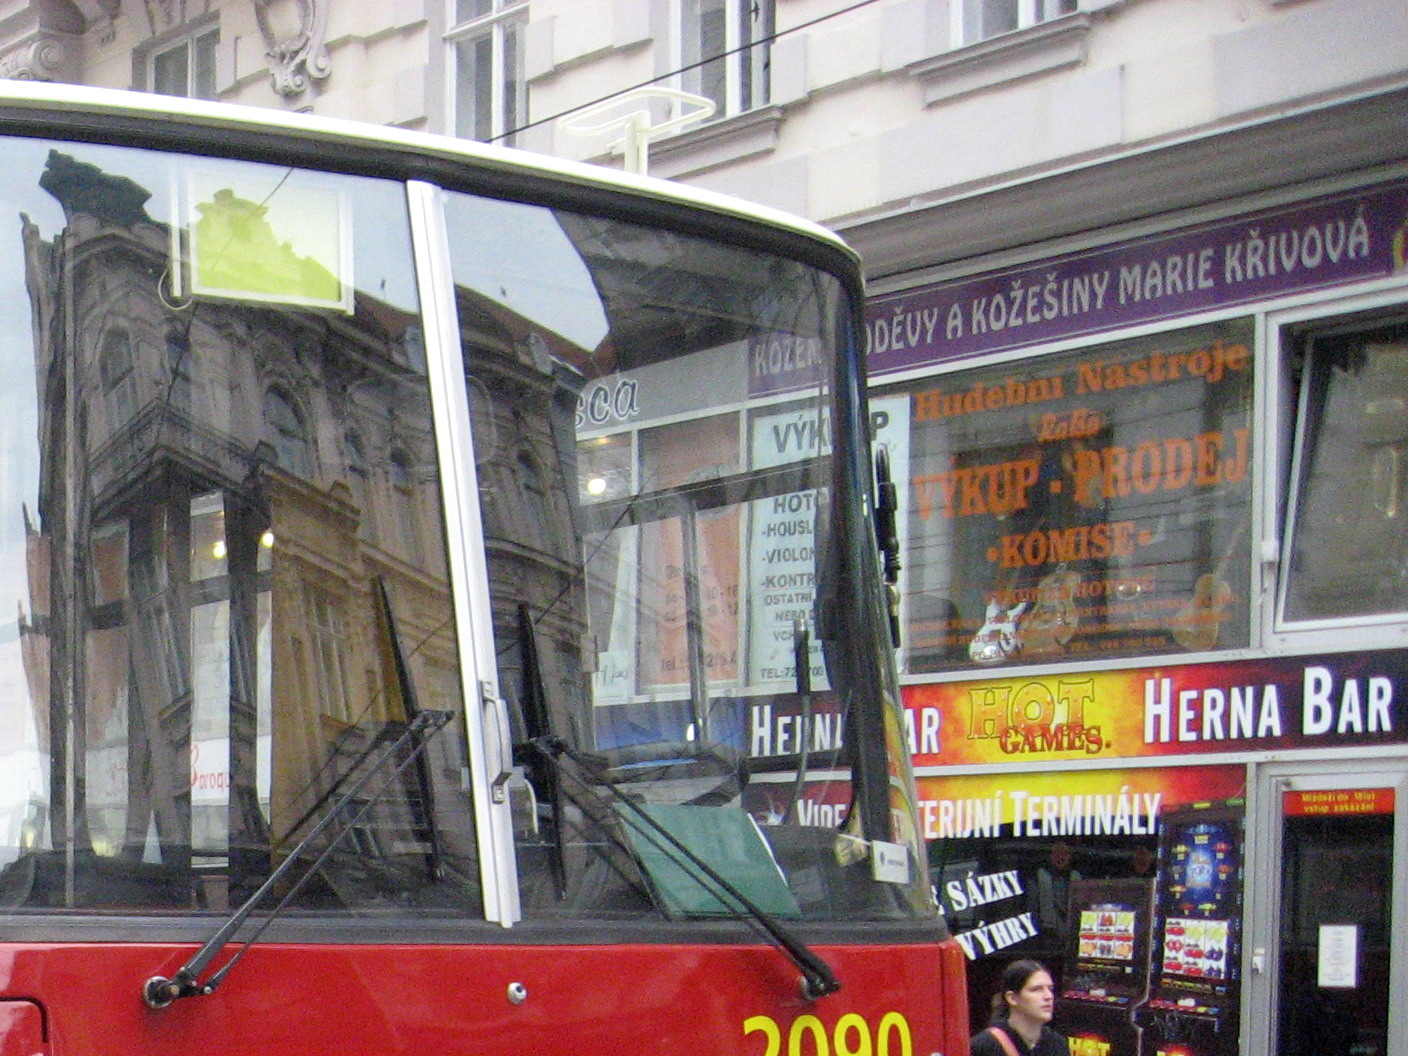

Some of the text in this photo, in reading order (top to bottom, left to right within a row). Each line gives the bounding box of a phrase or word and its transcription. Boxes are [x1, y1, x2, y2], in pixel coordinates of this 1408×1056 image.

[945, 303, 964, 341] A
[971, 270, 1109, 336] KOŽEŠINY
[1119, 250, 1215, 305] MARIE
[1224, 203, 1370, 284] KŘIVOVÁ
[912, 428, 1250, 520] VÝKUP PRODEJ
[999, 520, 1137, 569] KOMISE
[967, 678, 1096, 741] HOT
[1144, 665, 1393, 744] HERNA BAR
[1011, 785, 1163, 839] TERMINÁLY
[946, 870, 1025, 912] SÁZKY
[953, 911, 1040, 962] VÝHRY
